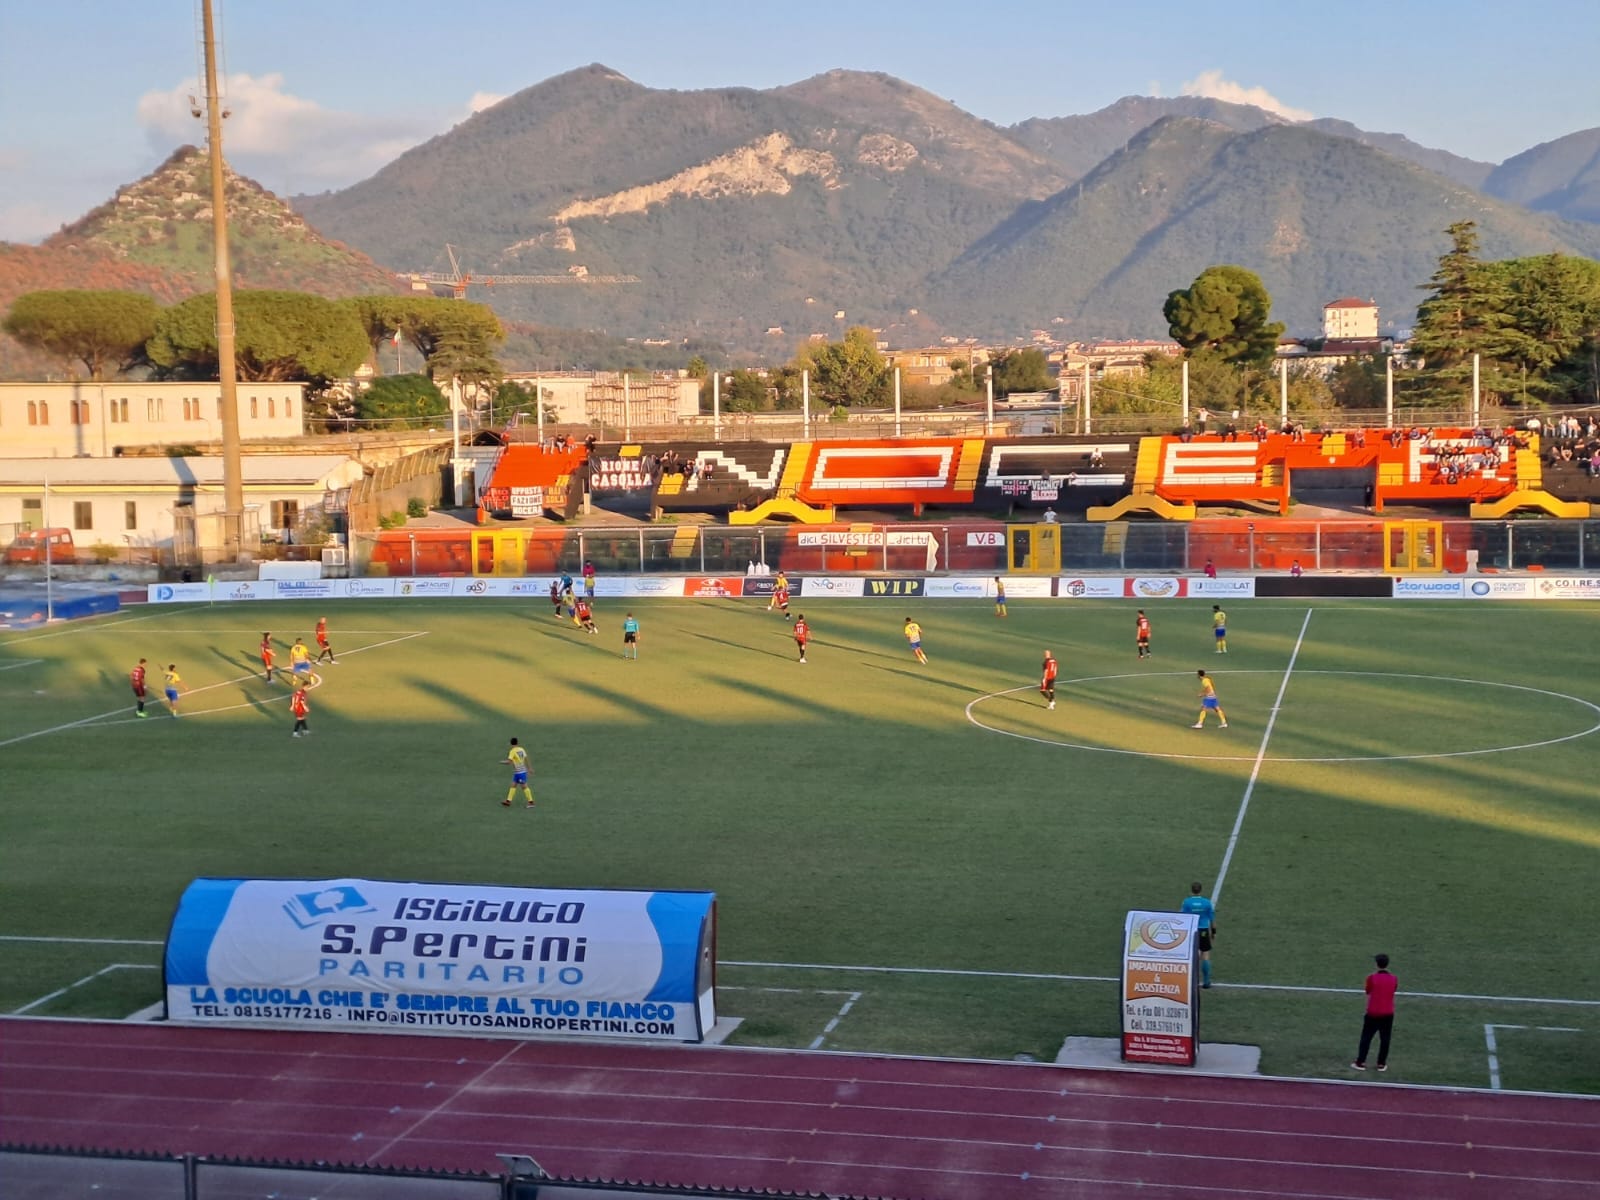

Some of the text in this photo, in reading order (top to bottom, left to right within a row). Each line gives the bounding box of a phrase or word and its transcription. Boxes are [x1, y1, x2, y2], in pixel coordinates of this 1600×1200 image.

[601, 460, 640, 473] RIONE
[591, 474, 652, 488] CASOLLA
[511, 495, 542, 504] FAZIONE
[821, 533, 882, 545] SILVESTER
[872, 581, 919, 594] WIP
[319, 959, 584, 985] PARITARIO
[1128, 961, 1187, 973] IMPIANTISTICA
[1134, 982, 1181, 994] ASSISTENZA
[191, 987, 674, 1021] LA SCUOLA CHE E' SEMPRE AL TUO FIANCO
[234, 1006, 332, 1020] 0815177216
[348, 1009, 675, 1035] INFO@ISTITUTOSANDROPERTINI.COM
